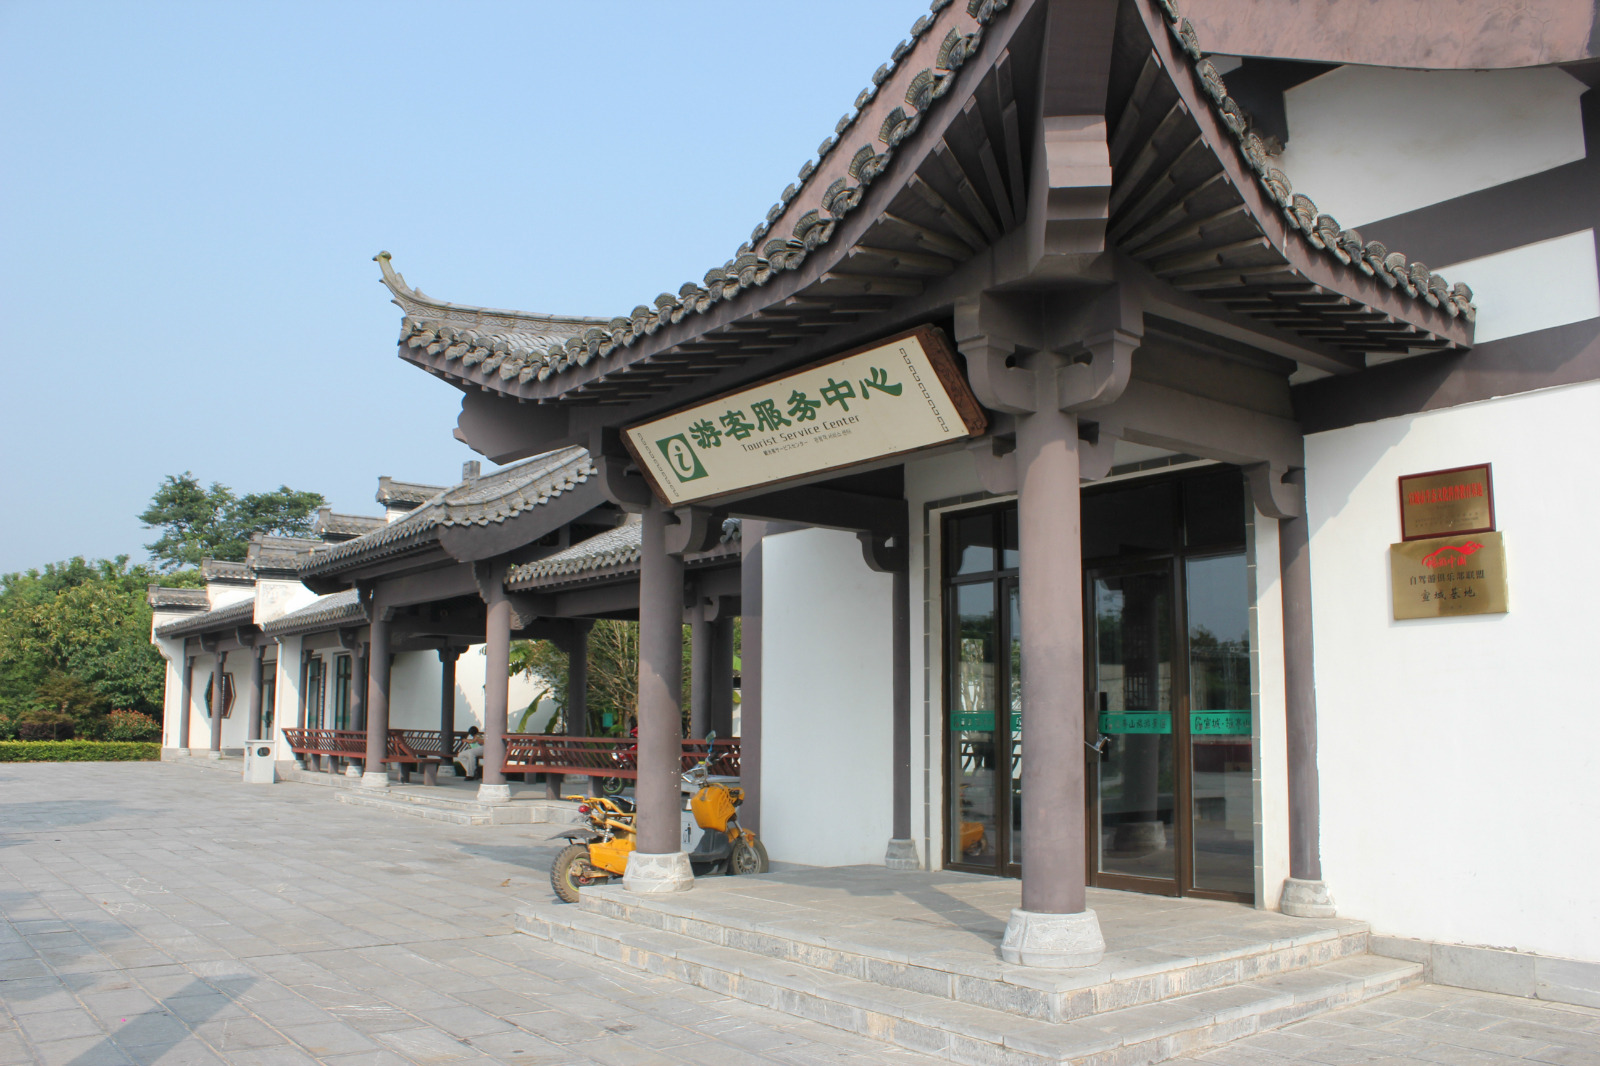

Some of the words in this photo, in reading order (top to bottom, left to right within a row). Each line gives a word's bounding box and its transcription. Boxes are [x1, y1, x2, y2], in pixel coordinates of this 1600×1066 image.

[688, 366, 903, 450] 游客服务中心
[740, 436, 777, 452] Tourist
[779, 425, 821, 442] Service
[823, 414, 860, 430] Center
[1410, 569, 1485, 586] 自驾游俱乐部联盟
[1420, 586, 1476, 602] 宣城基地
